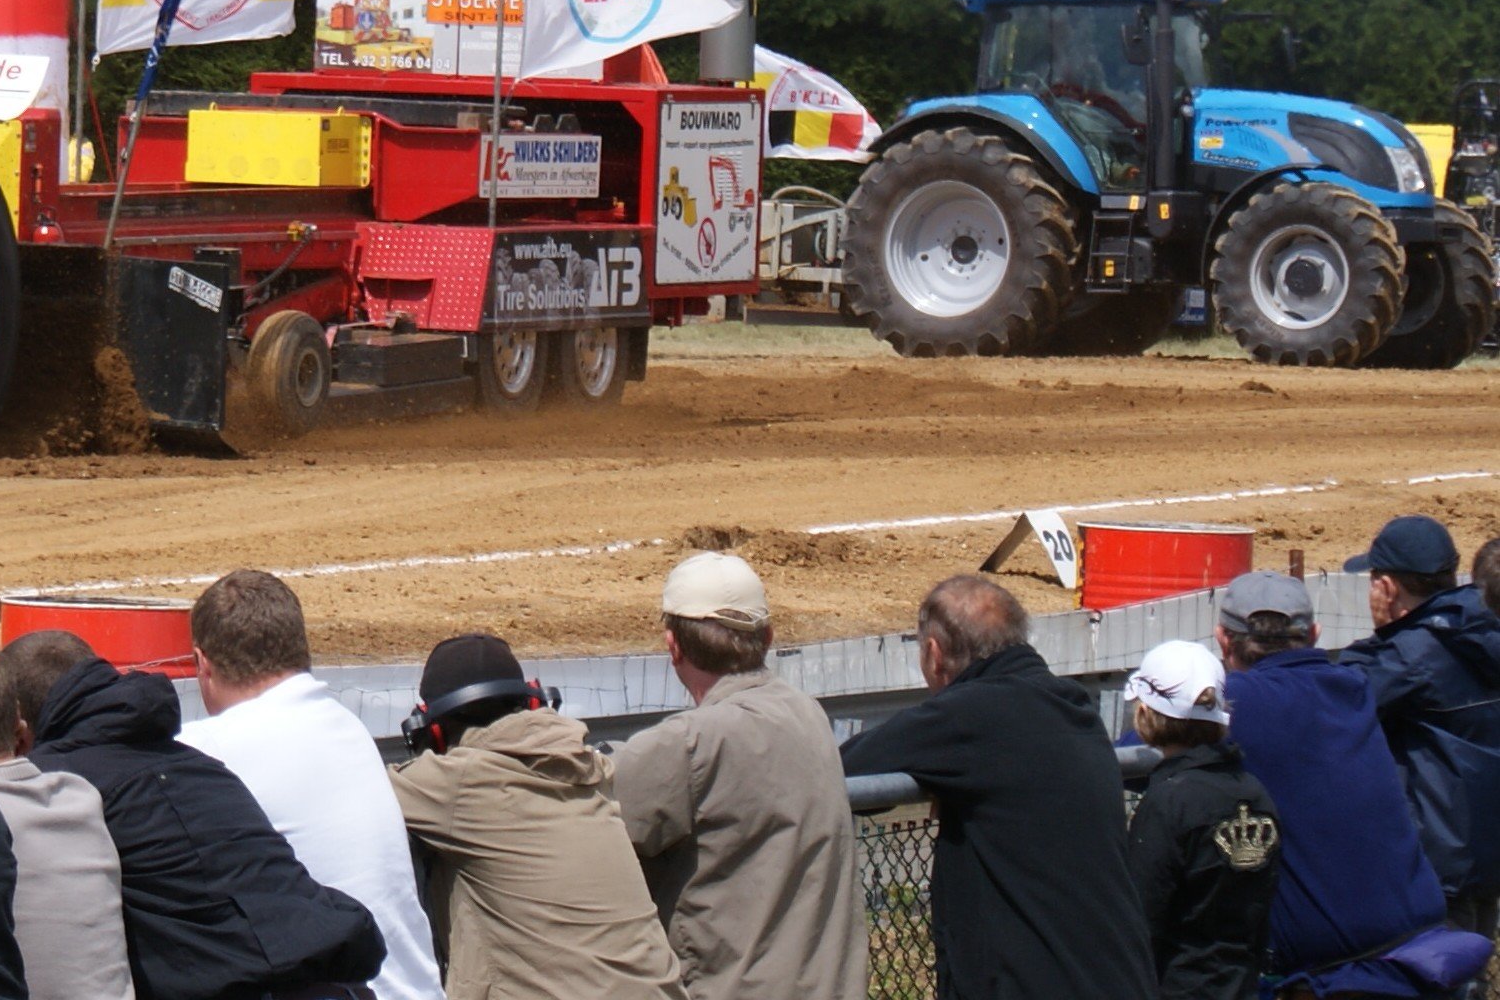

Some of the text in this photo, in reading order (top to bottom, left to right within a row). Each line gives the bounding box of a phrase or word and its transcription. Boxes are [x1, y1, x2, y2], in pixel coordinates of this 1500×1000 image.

[321, 52, 349, 67] TEL.
[380, 55, 388, 67] 3
[416, 55, 431, 70] 04
[680, 110, 742, 131] BOUWMARO
[552, 141, 599, 163] SCHILDERS
[549, 169, 559, 181] in
[497, 283, 586, 311] Tire Solutions
[1042, 530, 1074, 562] 20
